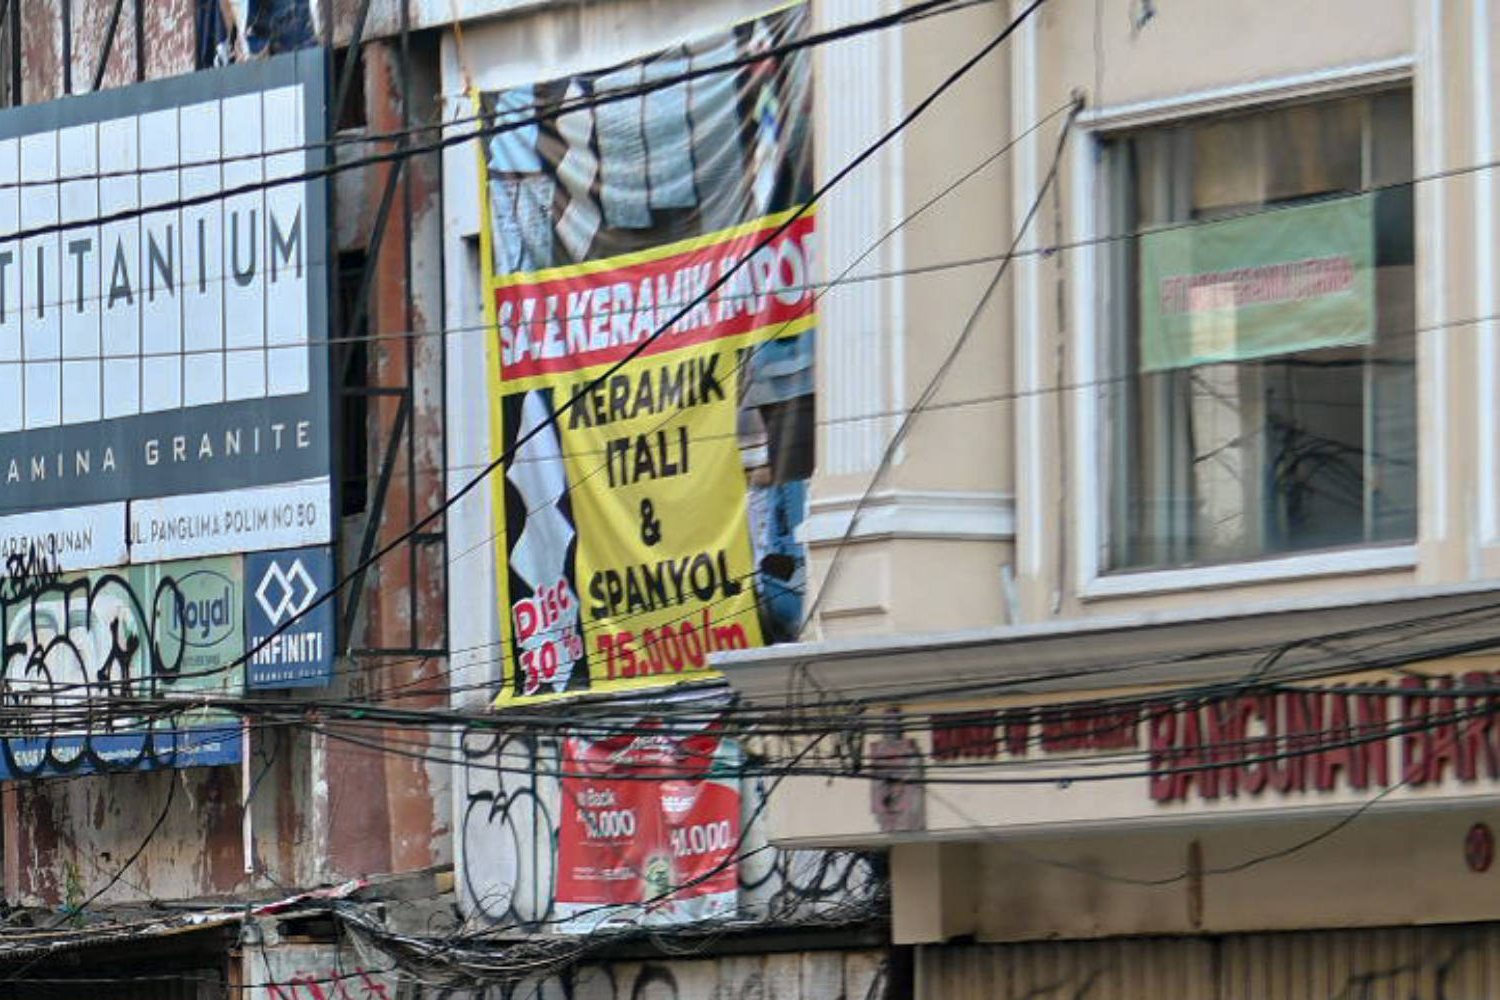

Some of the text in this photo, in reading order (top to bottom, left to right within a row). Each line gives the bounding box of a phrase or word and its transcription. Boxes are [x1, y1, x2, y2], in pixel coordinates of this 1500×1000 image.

[566, 262, 713, 353] KERAMIK
[569, 353, 725, 430] KERAMIK
[144, 421, 312, 466] GRANITE
[606, 426, 689, 488] ITALI
[150, 515, 221, 541] PANGLIMA
[225, 509, 270, 534] POLIM
[274, 505, 295, 529] NO
[640, 498, 661, 546] &
[589, 550, 742, 619] SPANYOL
[252, 631, 323, 666] INFINITI
[1151, 680, 1389, 801] BANGUNAN
